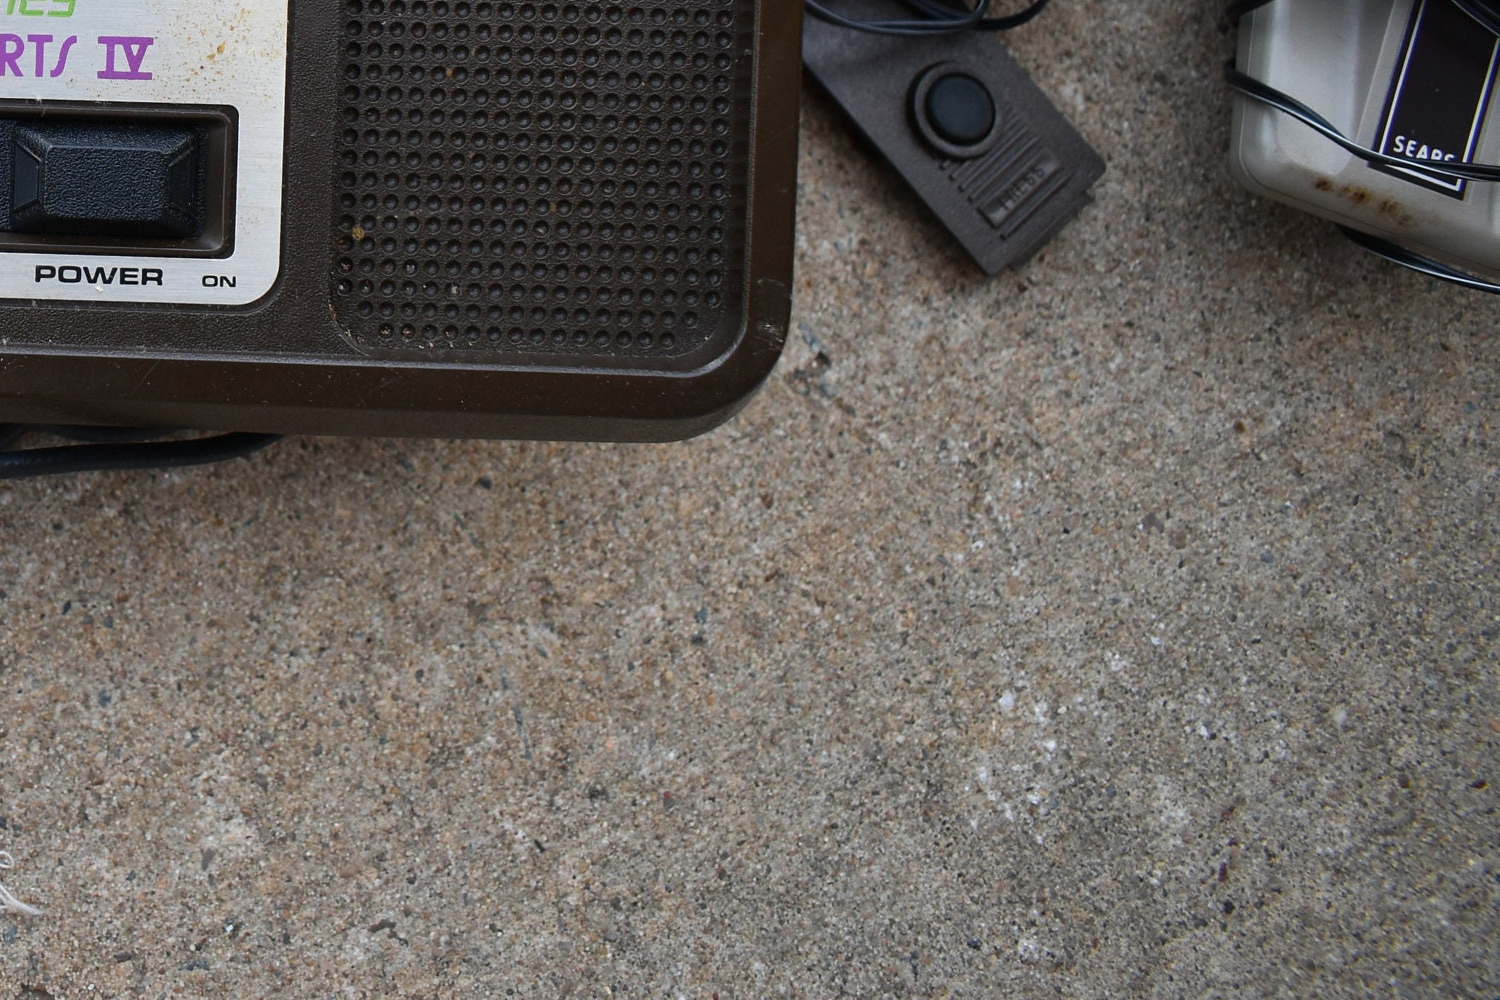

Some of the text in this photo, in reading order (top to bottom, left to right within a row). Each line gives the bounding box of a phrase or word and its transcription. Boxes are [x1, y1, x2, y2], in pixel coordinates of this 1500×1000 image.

[97, 35, 154, 80] IV
[35, 264, 163, 286] POWER
[202, 274, 237, 288] ON
